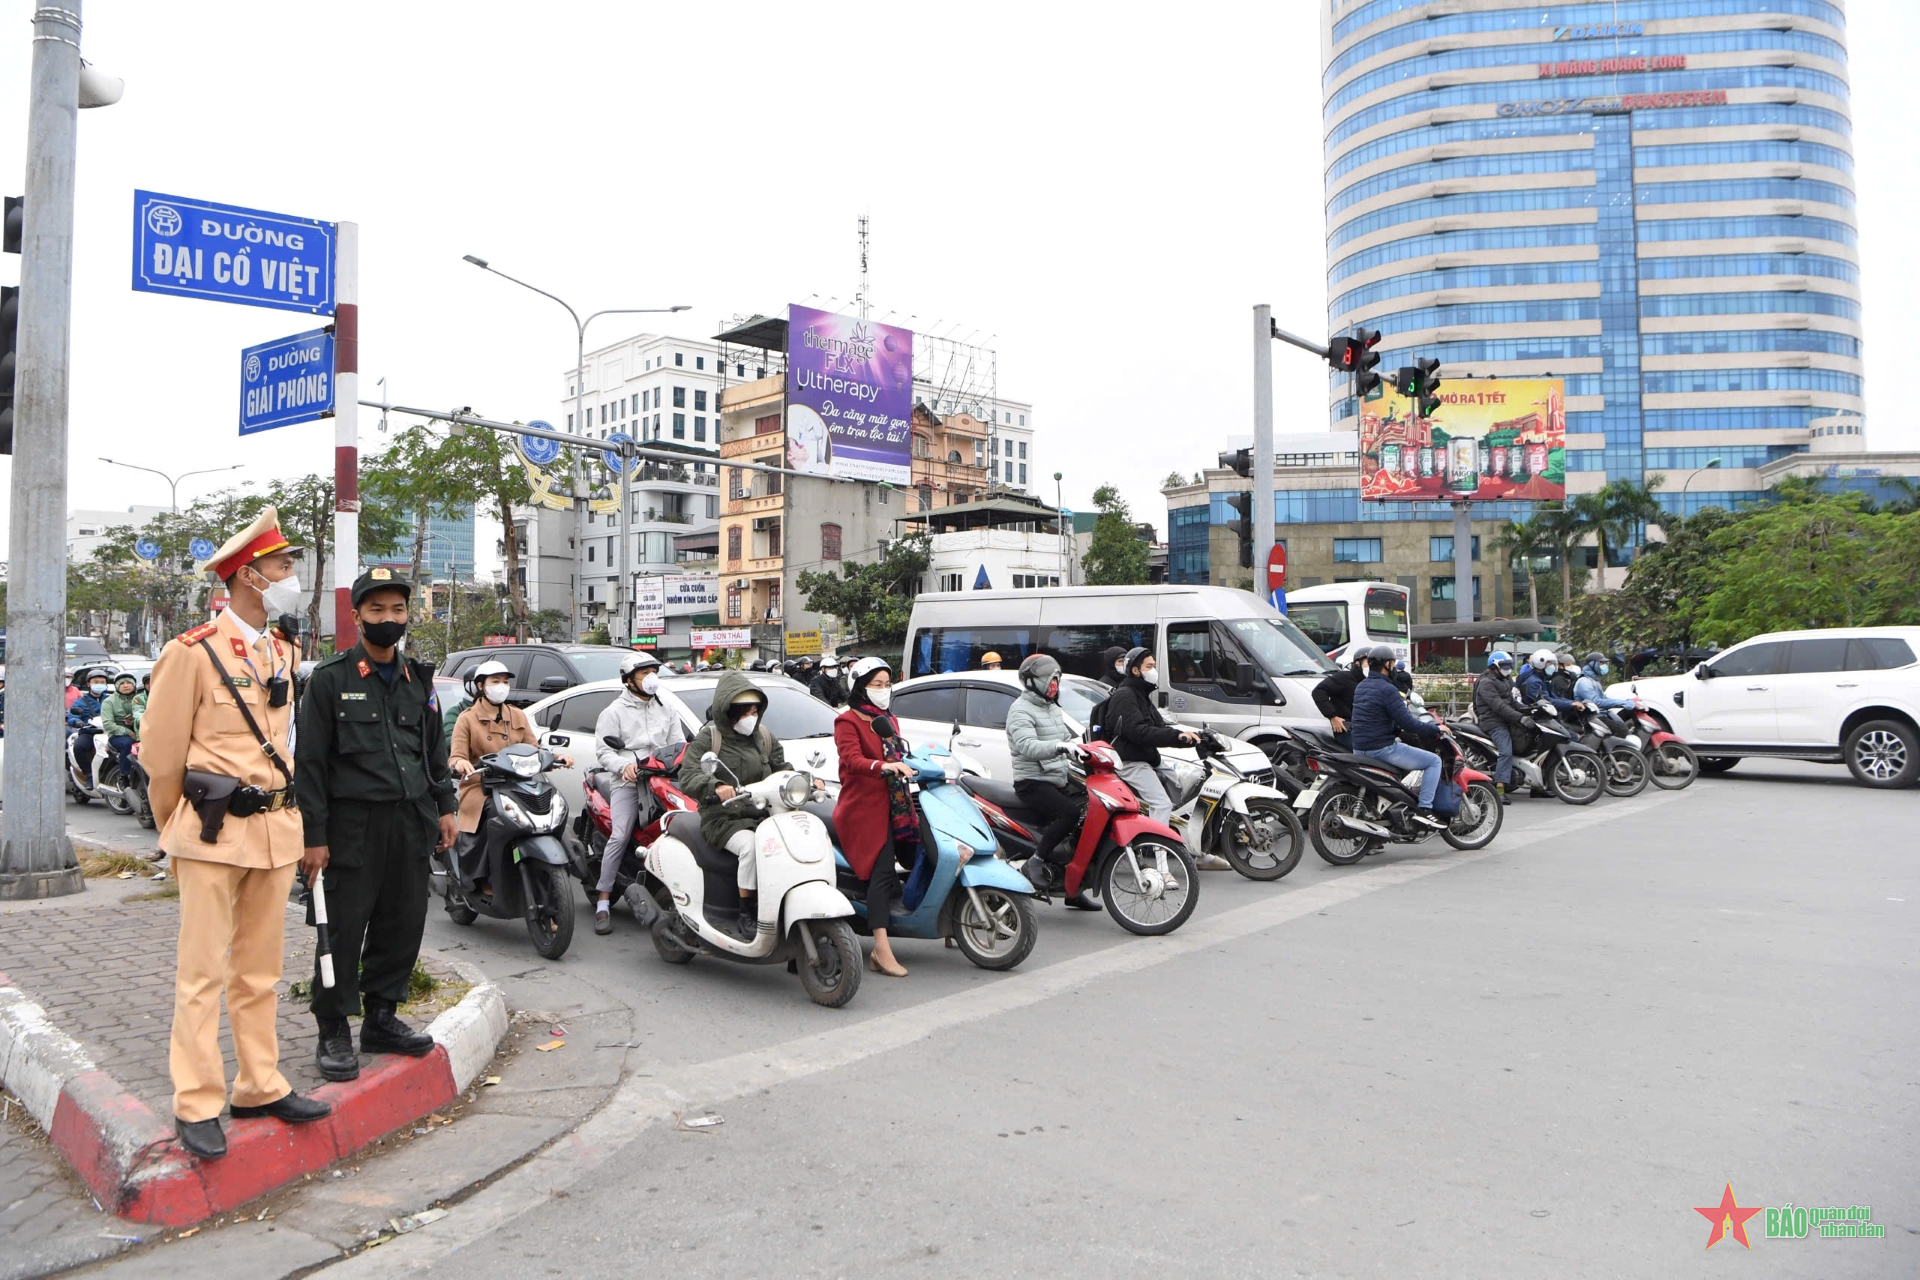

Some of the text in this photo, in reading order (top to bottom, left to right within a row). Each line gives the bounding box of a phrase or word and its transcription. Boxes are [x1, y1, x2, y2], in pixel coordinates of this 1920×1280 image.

[1570, 23, 1644, 39] DAIKIN
[1538, 62, 1553, 77] XI
[1557, 58, 1596, 75] MĂNG
[1651, 54, 1687, 70] LONG
[201, 218, 304, 250] ĐƯỜNG
[154, 242, 320, 300] ĐẠI CỒ VIỆT
[804, 326, 874, 364] thermage
[268, 346, 321, 372] ĐƯỜNG
[825, 352, 856, 374] FLX
[247, 368, 328, 418] GIẢI PHÓNG
[796, 368, 879, 402] Ultherapy
[1440, 392, 1458, 404] MỞ
[1460, 394, 1476, 403] RA
[1477, 392, 1484, 405] 1
[1486, 391, 1506, 403] TẾT
[821, 400, 840, 417] Da
[843, 409, 866, 424] căng
[868, 414, 888, 428] mặt
[828, 424, 845, 434] ôm
[847, 426, 868, 438] trọn
[870, 424, 884, 442] lộc
[667, 594, 682, 604] NHÔM
[684, 594, 696, 603] KÍNH
[708, 592, 718, 603] CẤP
[692, 582, 705, 592] CUỐN
